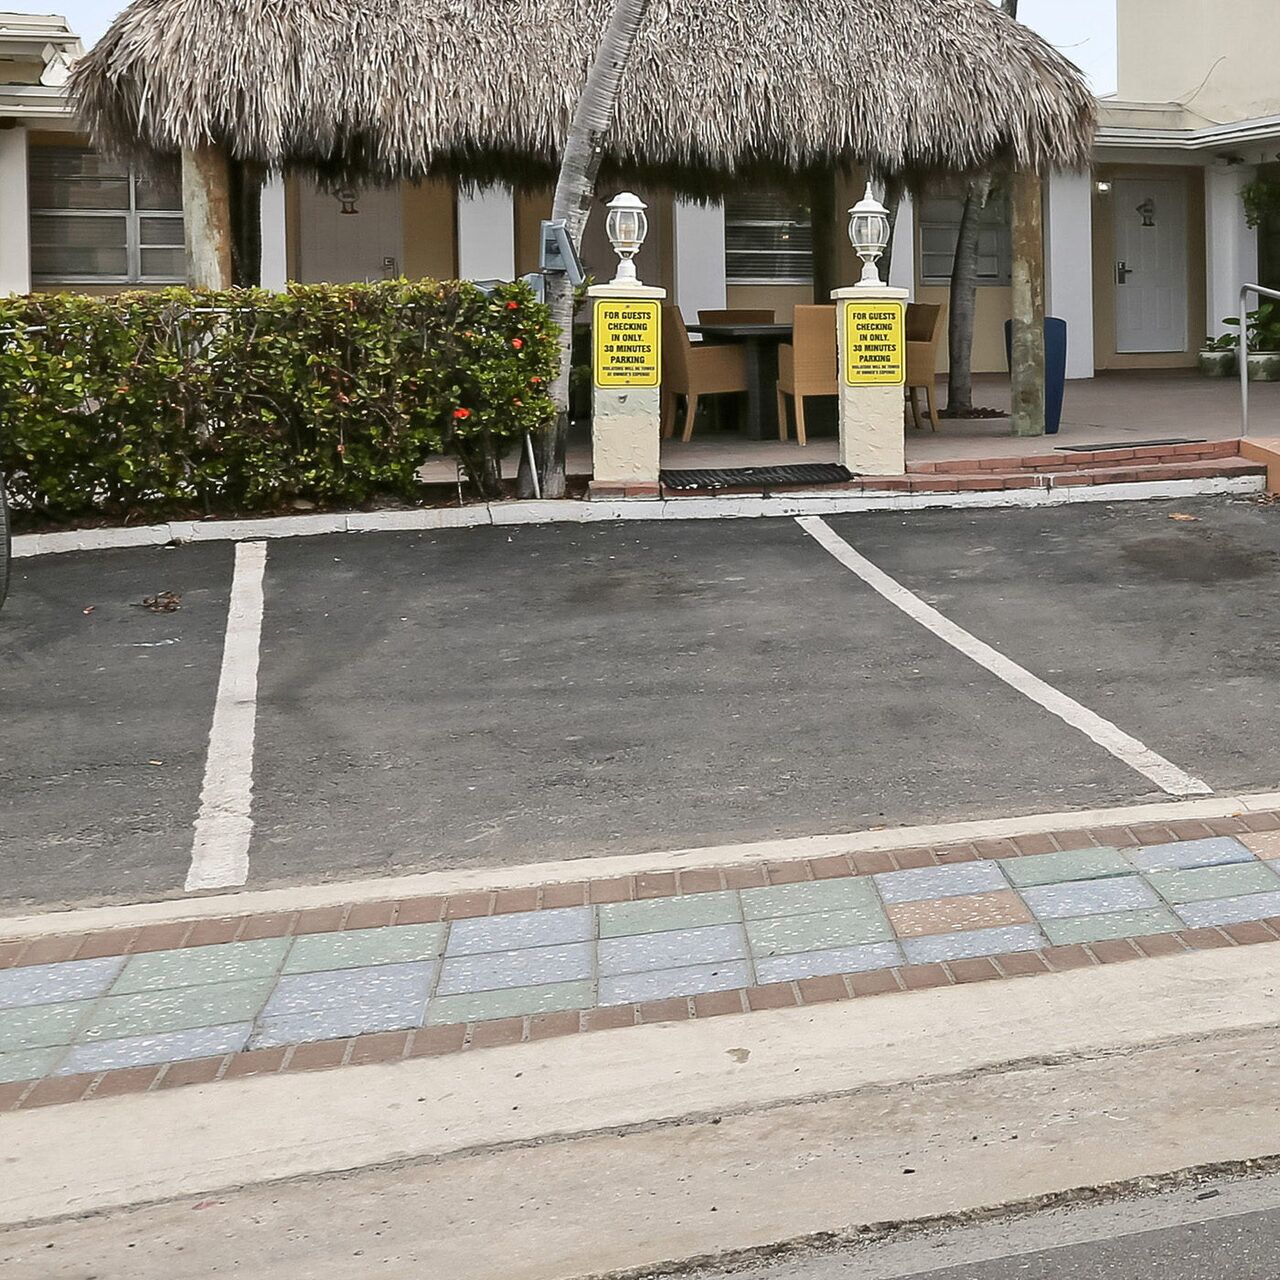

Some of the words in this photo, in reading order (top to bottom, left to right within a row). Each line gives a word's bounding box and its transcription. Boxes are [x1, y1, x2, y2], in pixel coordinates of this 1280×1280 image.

[604, 311, 619, 320] FOR
[622, 311, 651, 320] GUESTS
[853, 312, 867, 320] FOR
[868, 312, 896, 320] GUESTS
[608, 323, 647, 331] CHECKING
[856, 323, 892, 331] CHECKING
